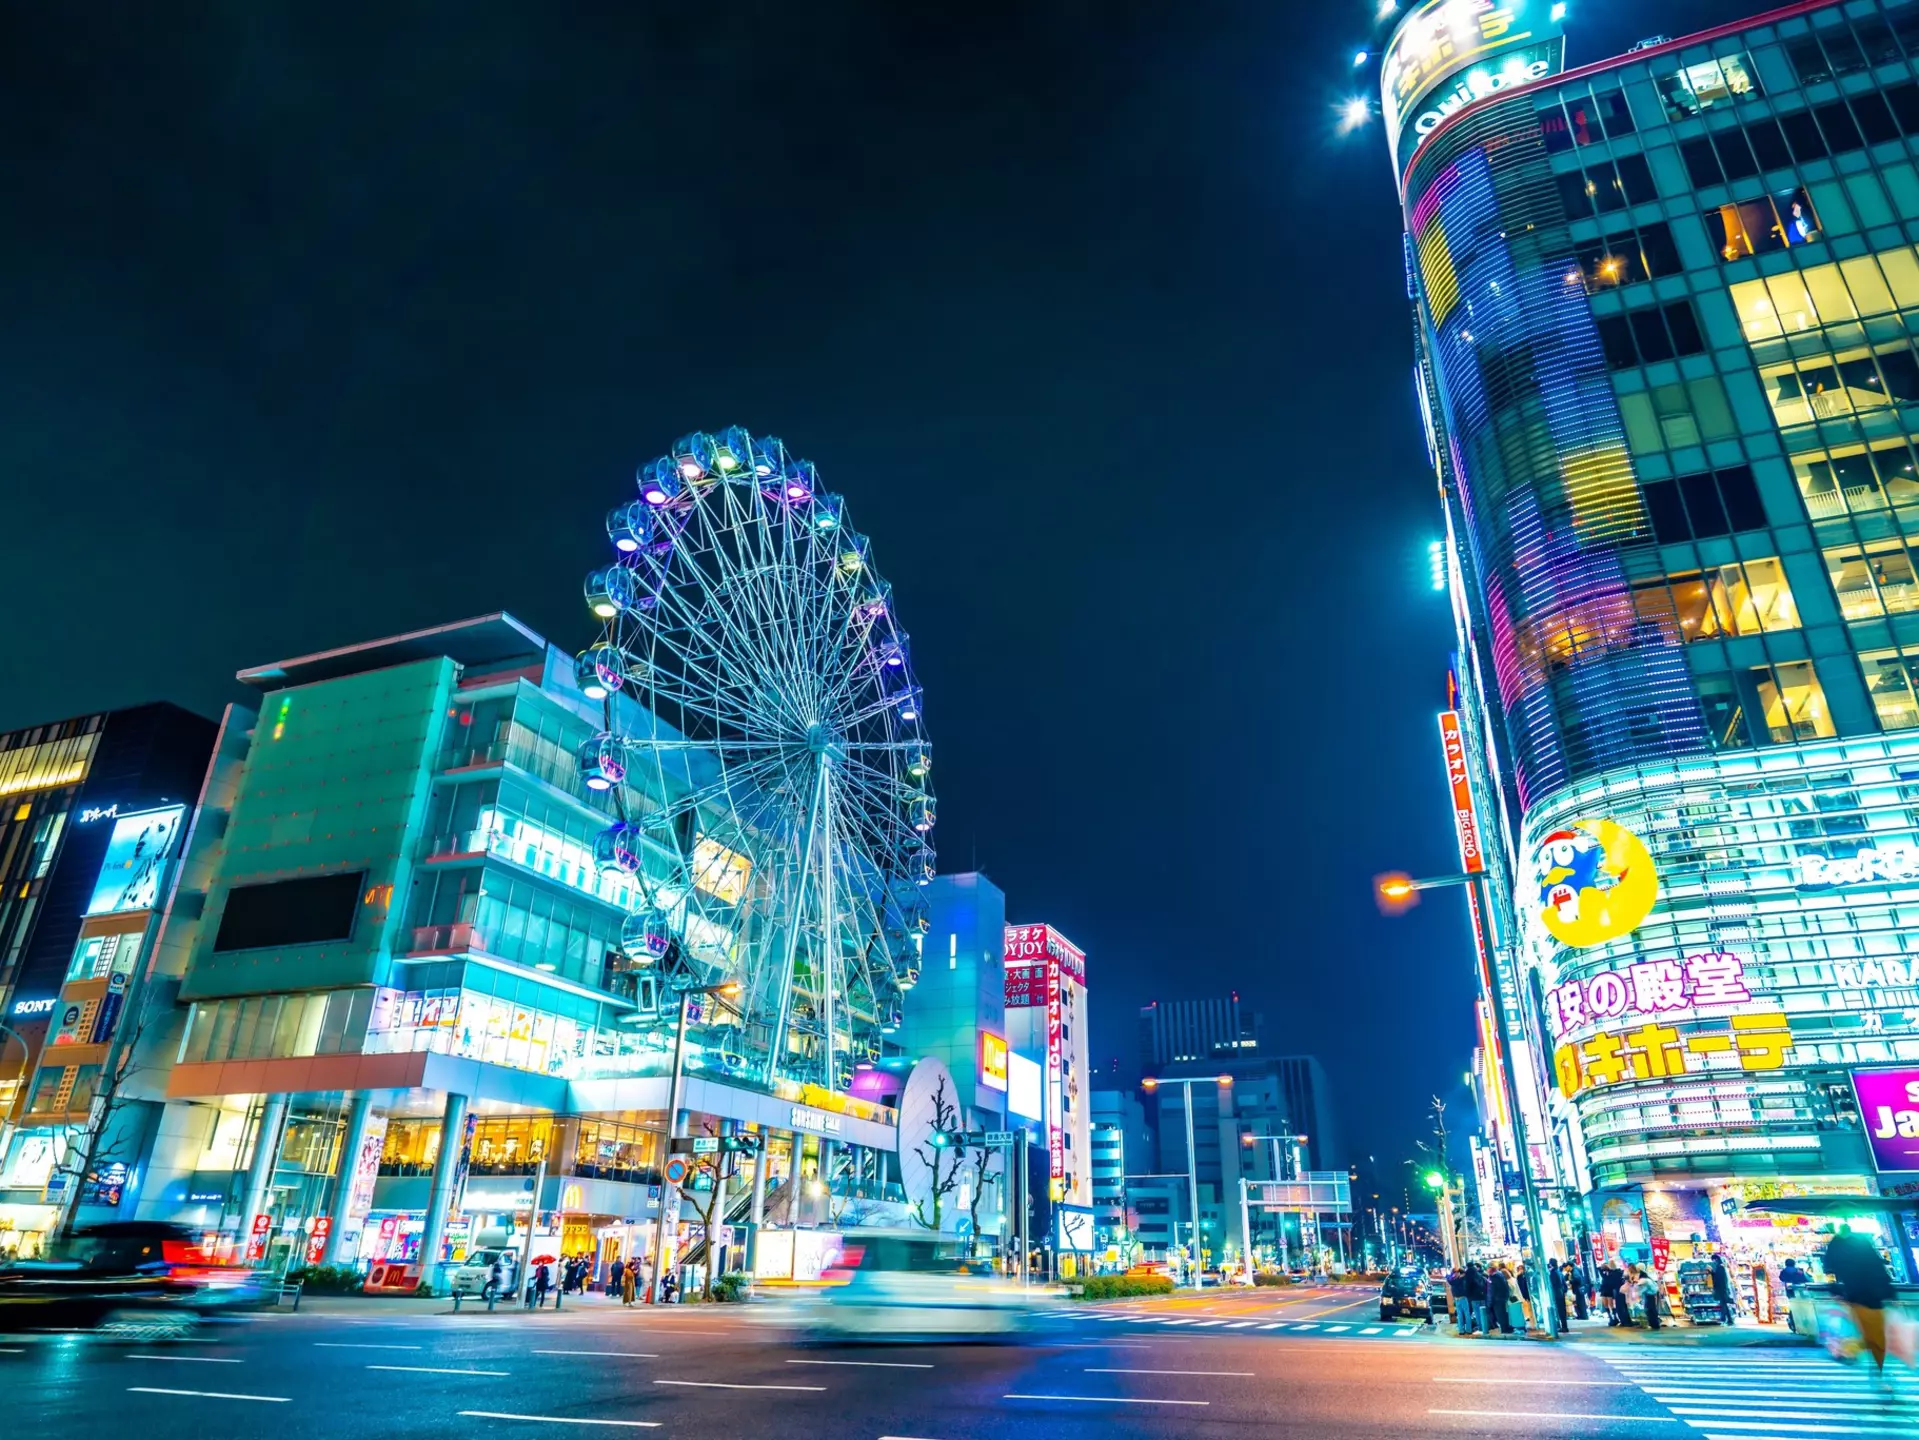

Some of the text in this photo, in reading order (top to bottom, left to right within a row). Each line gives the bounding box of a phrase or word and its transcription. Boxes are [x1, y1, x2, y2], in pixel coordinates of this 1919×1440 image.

[1445, 729, 1467, 785] カラオケ
[1458, 809, 1477, 858] BIG ECHO
[1005, 928, 1043, 942] ラオケ
[14, 999, 56, 1014] SONY
[1049, 960, 1060, 1035] カラオケ
[791, 1107, 826, 1132] SUNSHINE
